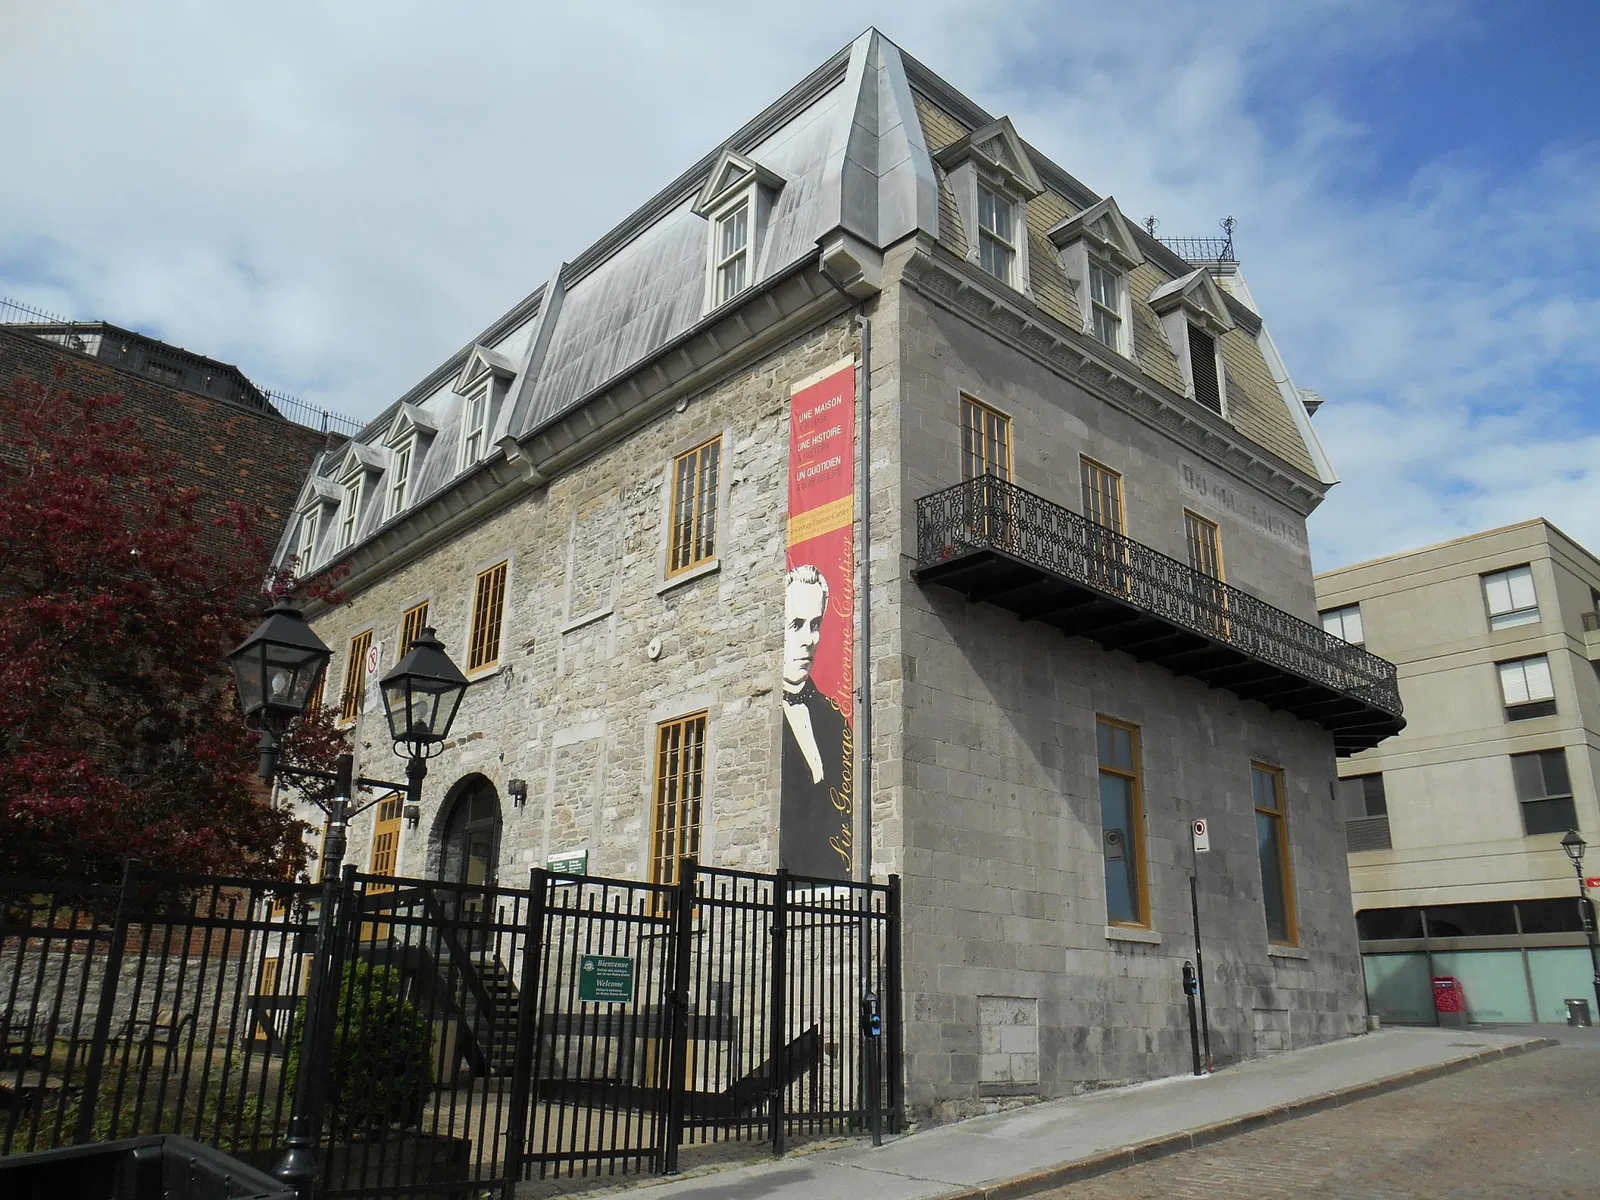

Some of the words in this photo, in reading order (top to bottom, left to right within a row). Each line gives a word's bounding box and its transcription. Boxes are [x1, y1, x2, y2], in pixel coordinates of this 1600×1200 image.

[798, 409, 812, 423] UNE
[814, 395, 842, 416] MAISON
[797, 438, 811, 452] UNE
[812, 424, 842, 446] HISTOIRE
[796, 469, 806, 481] UN
[806, 455, 842, 477] QUOTIDIEN
[831, 536, 853, 622] Cartier
[829, 823, 853, 873] Sir
[597, 960, 629, 968] Bienvenue
[596, 979, 624, 988] Welcome
